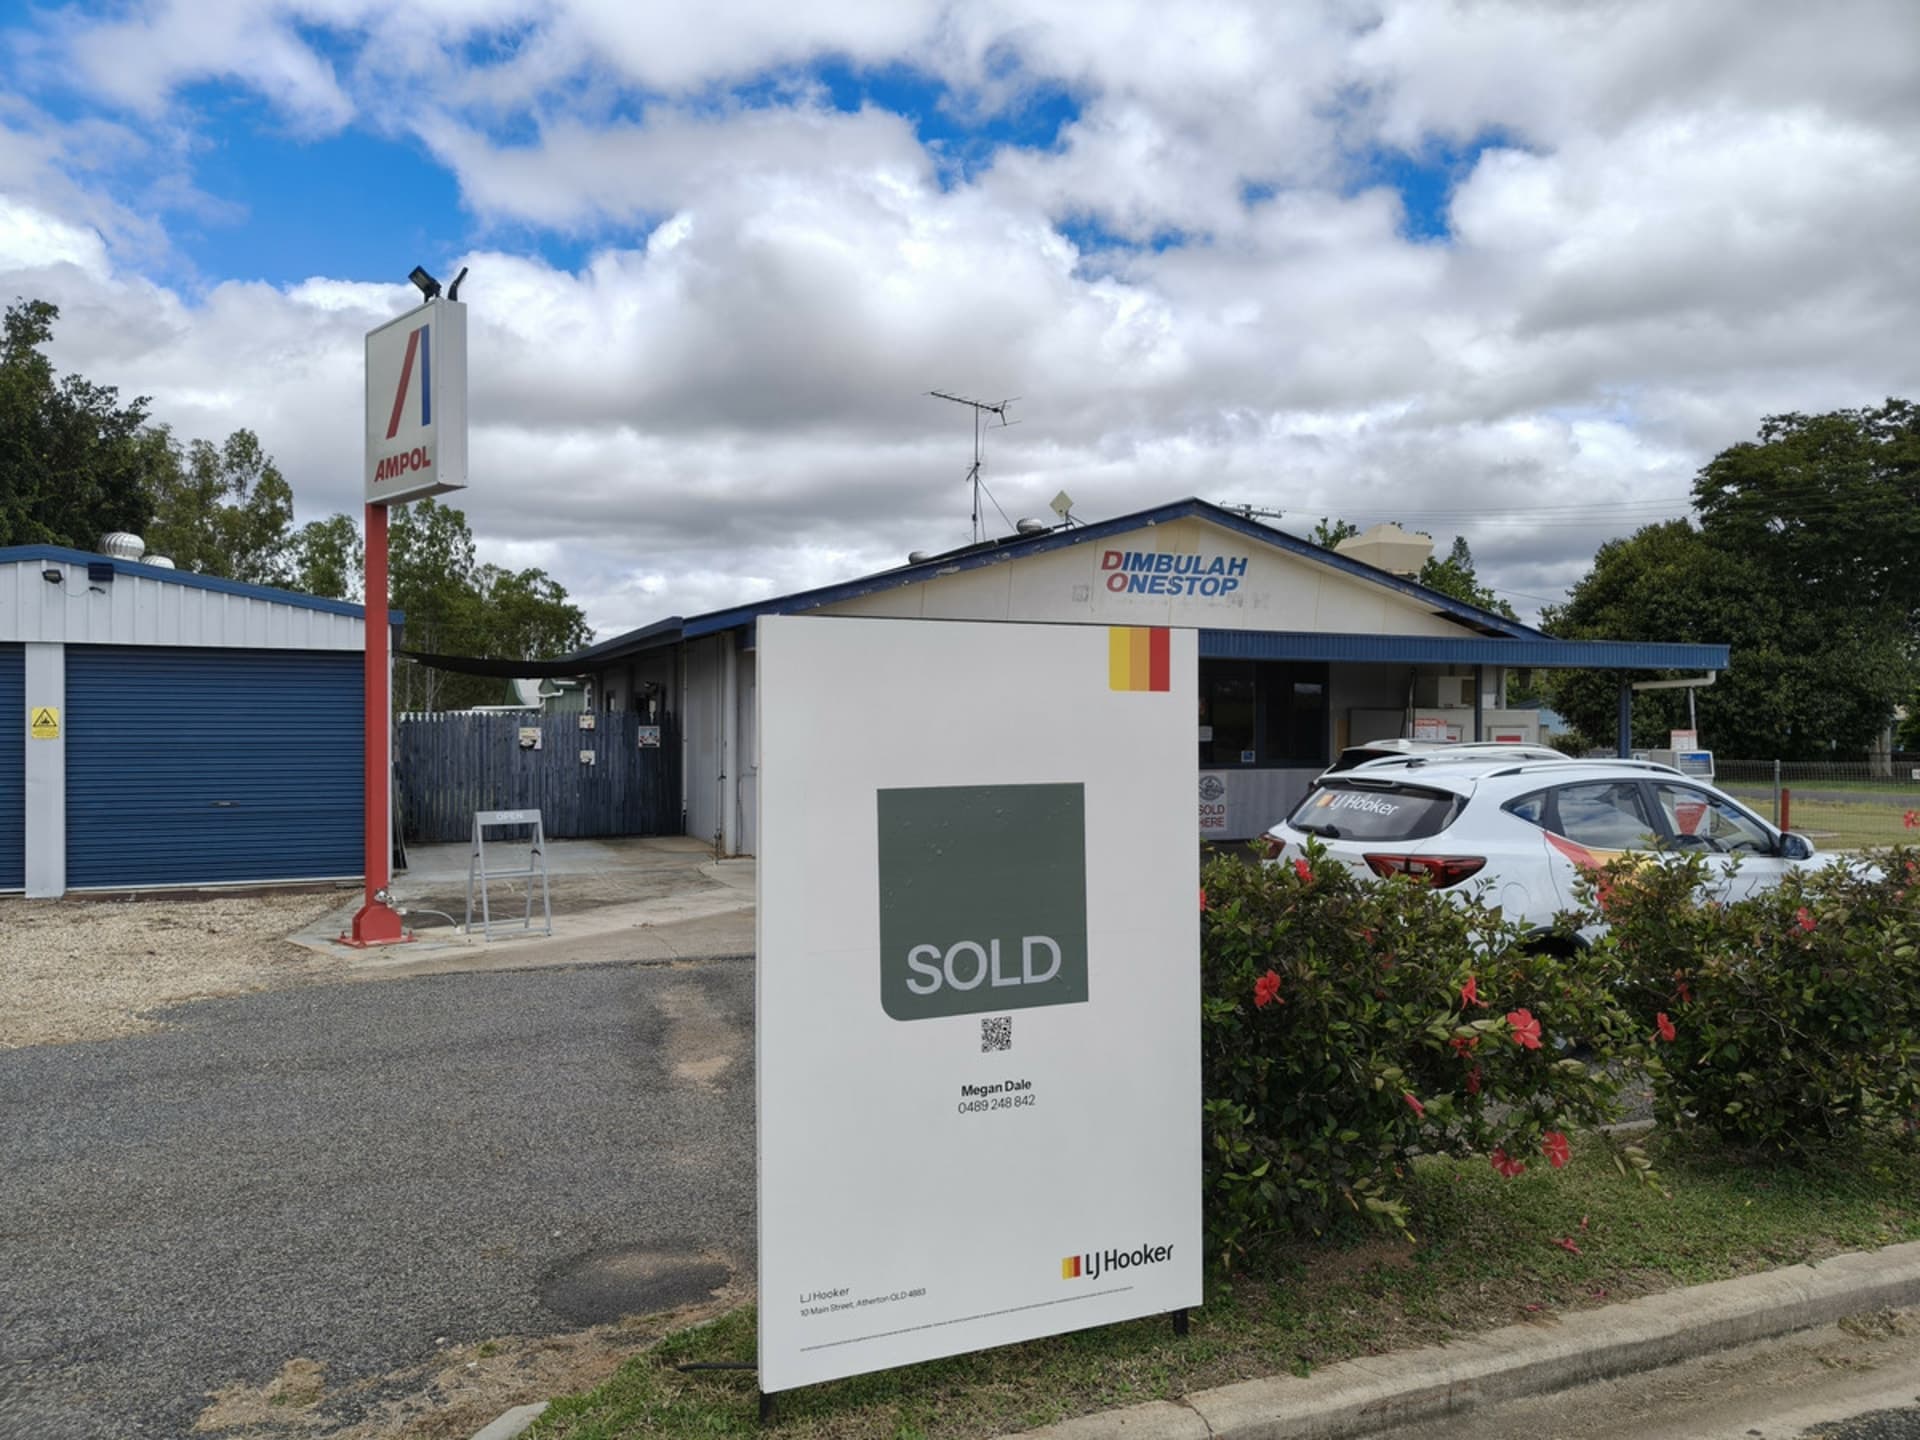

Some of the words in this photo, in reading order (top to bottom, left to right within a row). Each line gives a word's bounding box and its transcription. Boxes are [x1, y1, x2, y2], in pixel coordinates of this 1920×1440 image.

[374, 446, 431, 482] AMPOL
[1101, 550, 1248, 576] DIMBULAH
[1106, 572, 1239, 596] ONESTOP
[1343, 794, 1399, 816] Hooker
[906, 935, 1062, 995] SOLD
[961, 1084, 1003, 1097] Megan
[1004, 1079, 1032, 1092] Dale
[958, 1099, 989, 1114] 0489
[991, 1096, 1012, 1109] 248
[1014, 1094, 1036, 1108] 842
[1085, 1251, 1100, 1280] LJ
[1104, 1243, 1174, 1272] Hooker
[810, 1305, 829, 1315] Main
[856, 1295, 889, 1307] Atherton
[813, 1287, 850, 1301] Hooker
